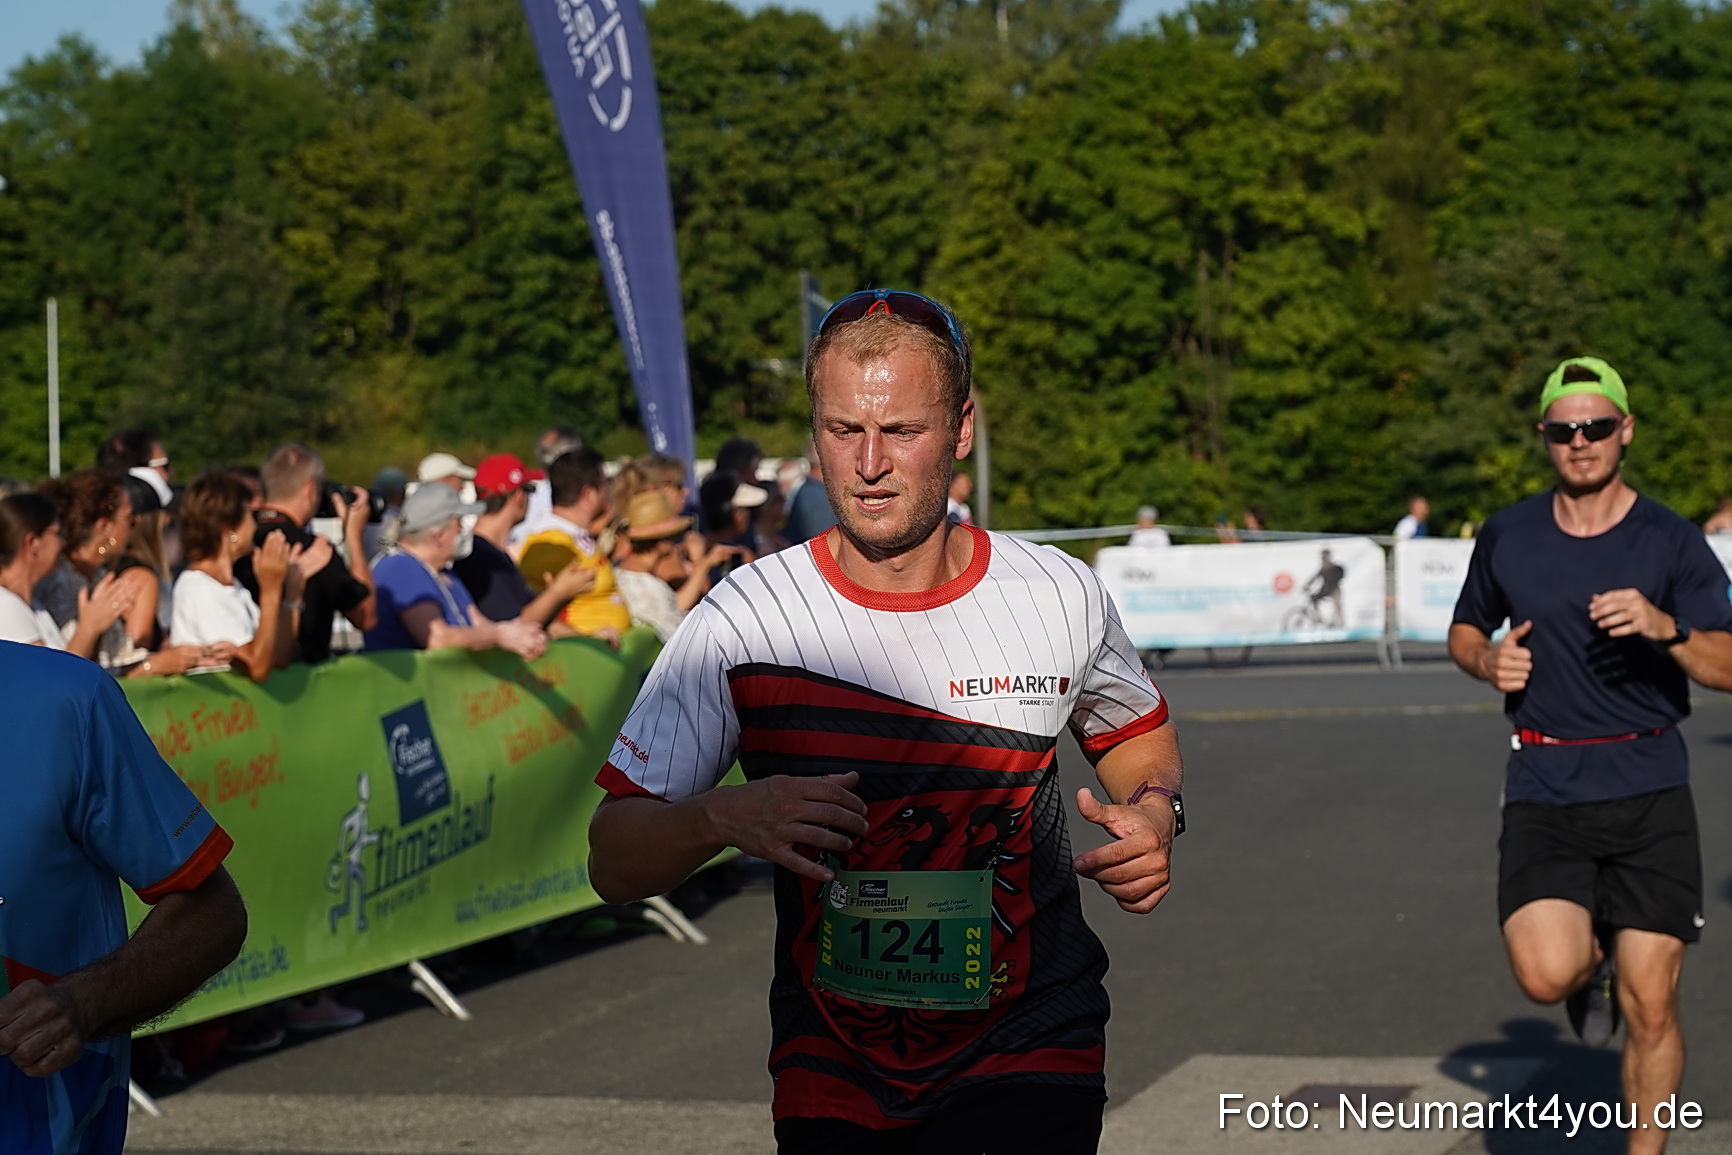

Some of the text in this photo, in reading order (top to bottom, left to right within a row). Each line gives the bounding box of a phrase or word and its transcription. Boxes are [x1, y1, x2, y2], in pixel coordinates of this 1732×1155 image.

[950, 675, 1057, 698] NEUMARKT
[850, 896, 909, 907] Firmenlauf
[821, 920, 833, 966] RUN
[850, 919, 945, 964] 124
[965, 926, 982, 990] 2022
[834, 957, 961, 984] Neuner Markus
